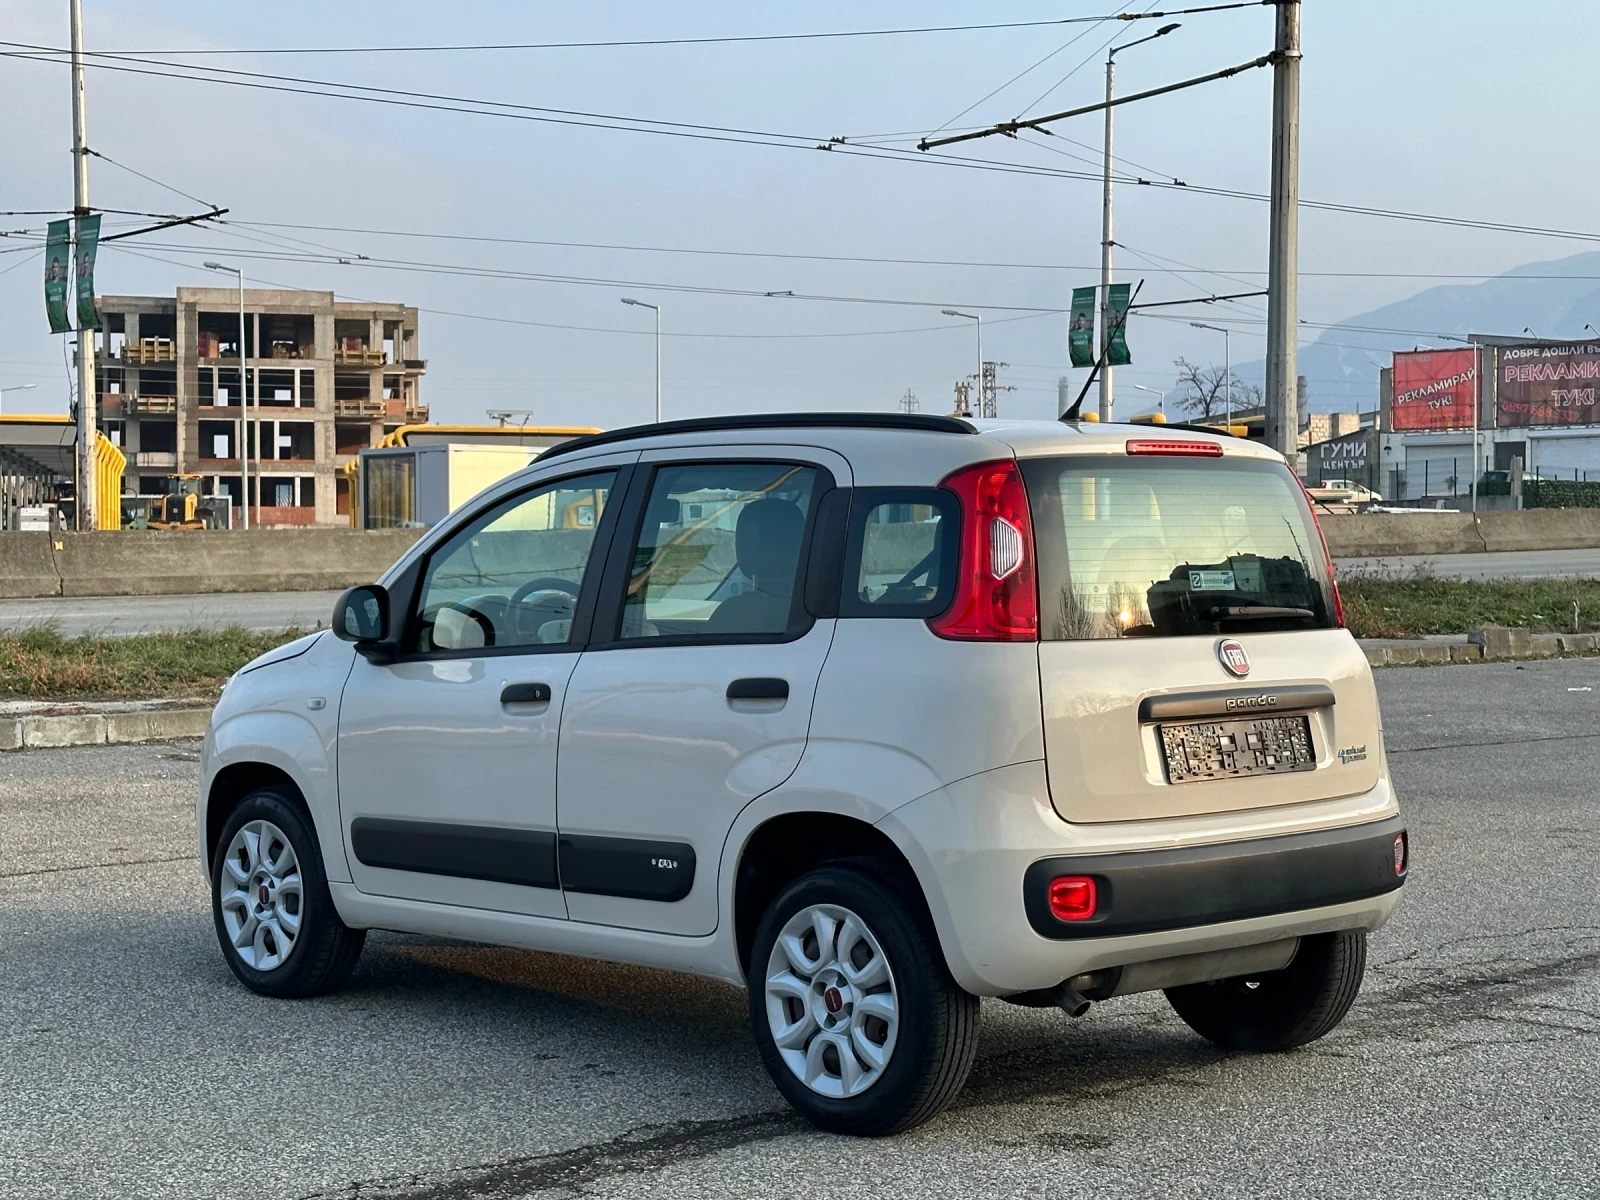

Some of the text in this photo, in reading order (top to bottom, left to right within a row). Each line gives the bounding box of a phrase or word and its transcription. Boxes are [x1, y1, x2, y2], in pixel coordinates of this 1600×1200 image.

[1503, 348, 1540, 360] ДОБРЕ
[1541, 345, 1585, 358] ДОШЛИ
[1397, 367, 1475, 405] РЕКЛАМИРАЙ
[1427, 394, 1453, 410] ТУК!
[1551, 388, 1595, 407] ТУК!
[1320, 441, 1367, 459] ГУМИ
[1323, 459, 1365, 470] ЦЕНТЪР
[1226, 648, 1246, 667] FIAT
[1226, 693, 1277, 711] panda
